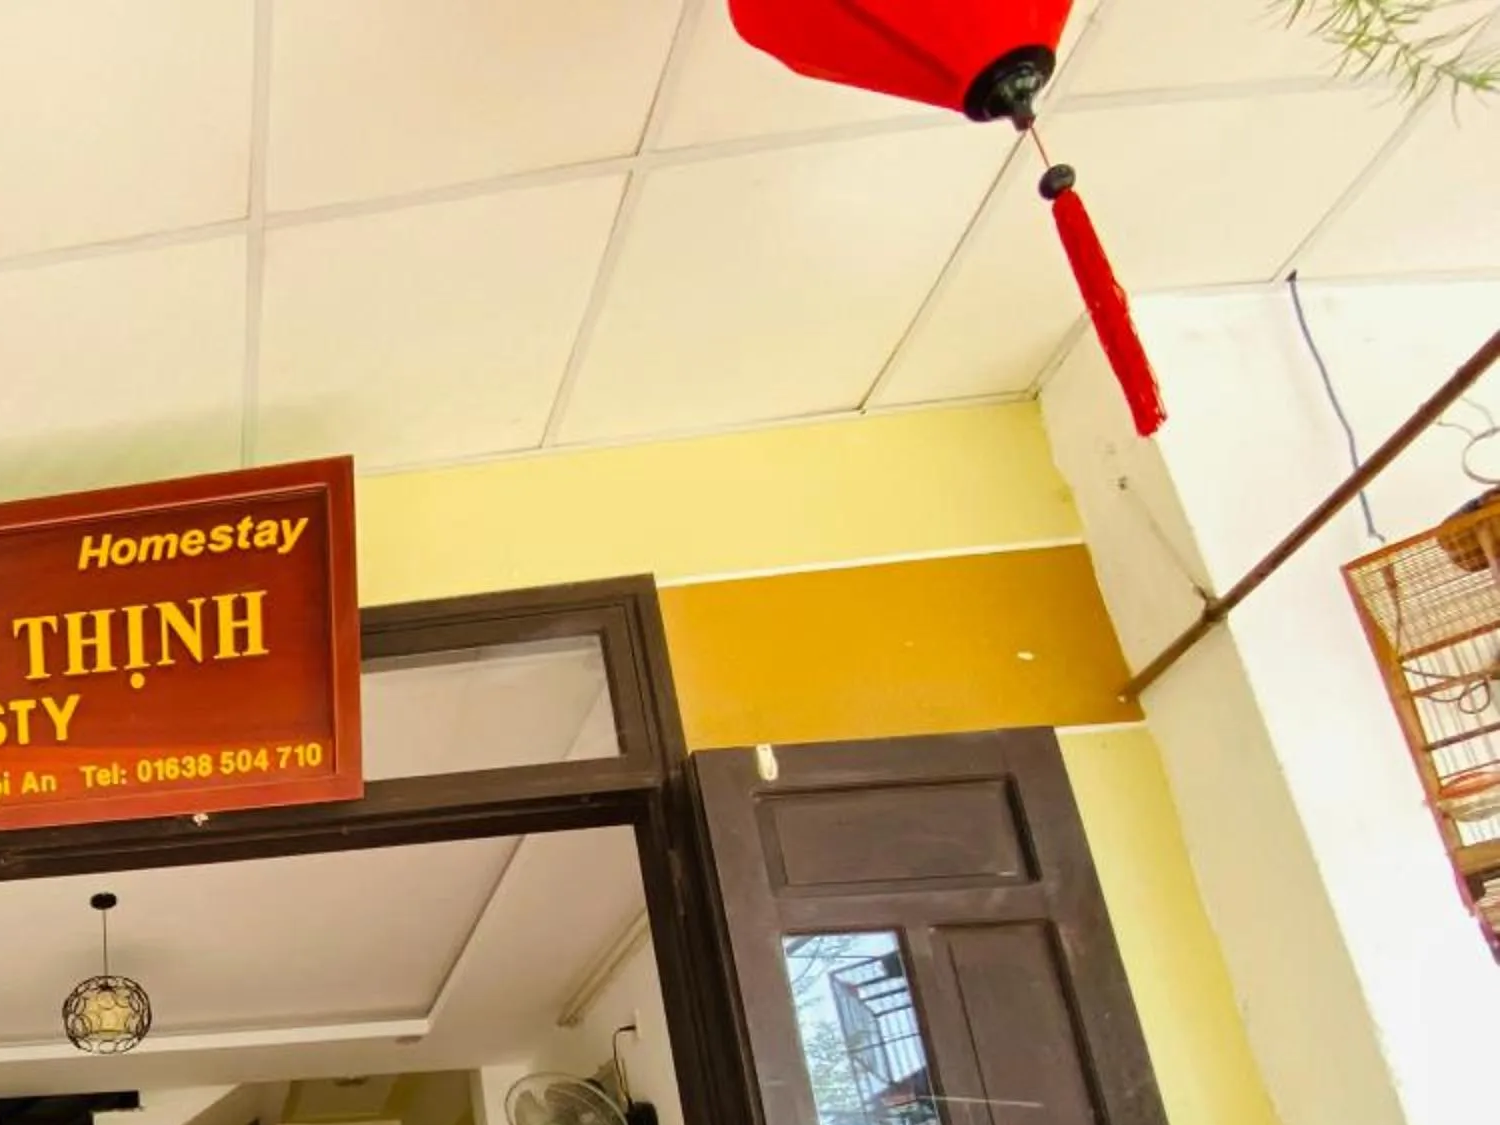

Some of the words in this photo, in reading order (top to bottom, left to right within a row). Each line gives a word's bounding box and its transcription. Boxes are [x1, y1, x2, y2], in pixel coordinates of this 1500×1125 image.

[78, 516, 308, 570] Homestay
[13, 590, 269, 689] THỊNH
[21, 772, 56, 794] An
[80, 763, 127, 788] Tel:
[136, 754, 213, 783] 01638
[219, 748, 268, 775] 504
[275, 742, 323, 769] 710
